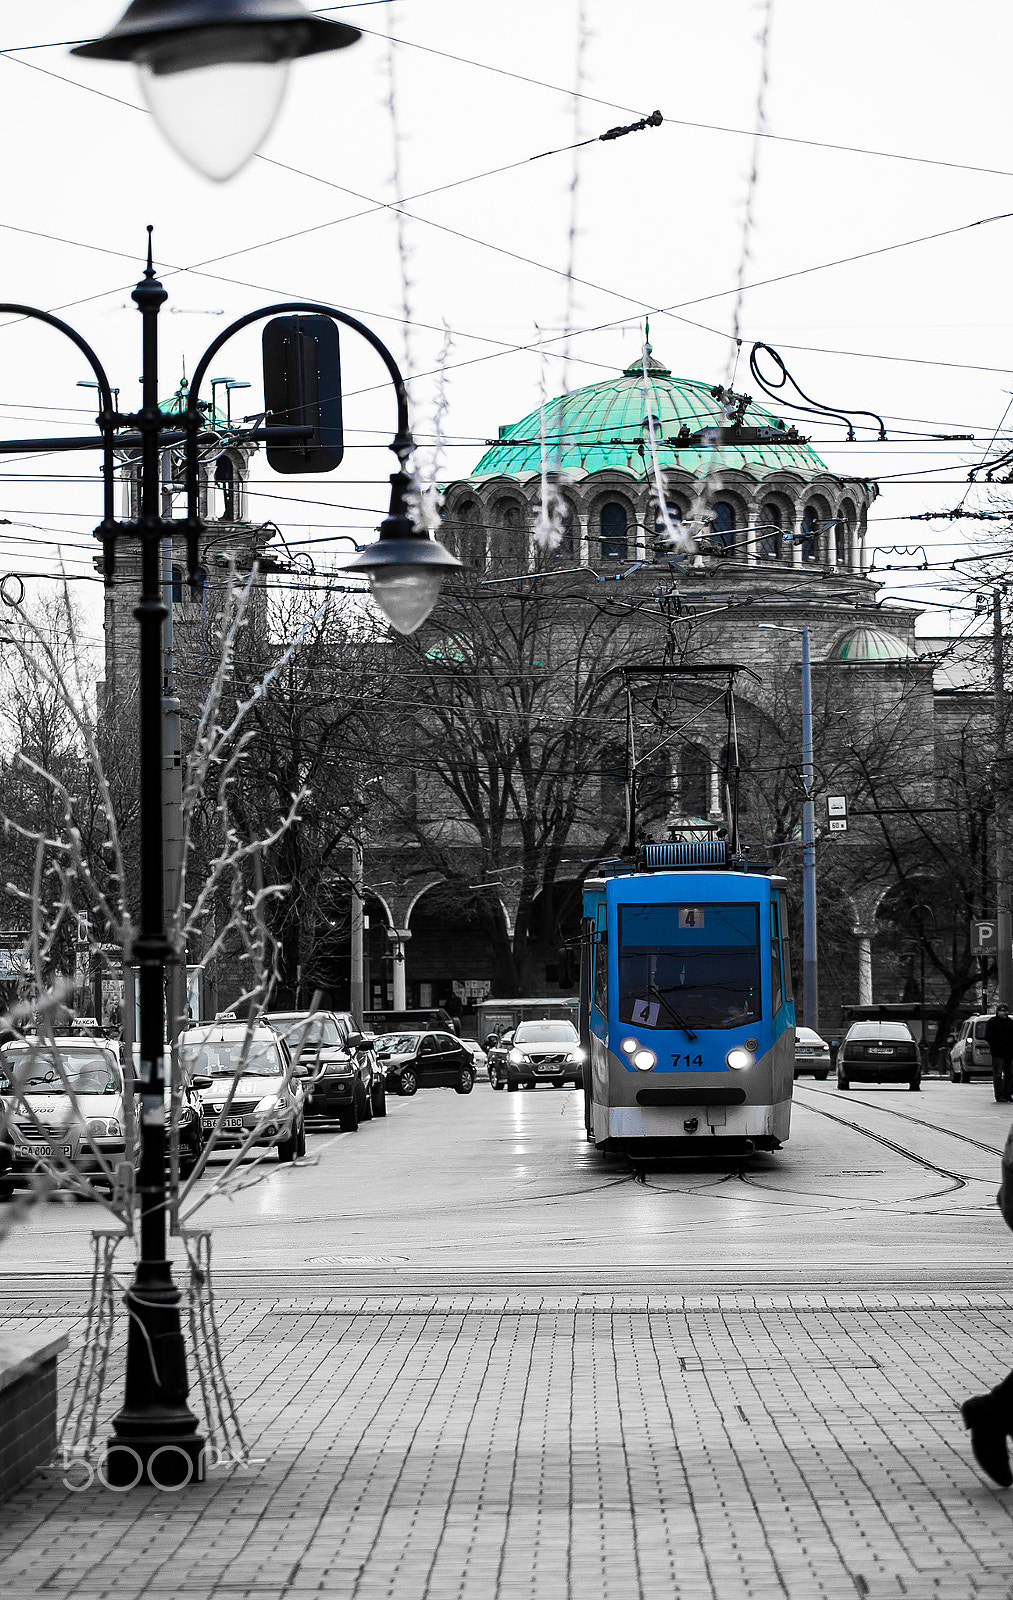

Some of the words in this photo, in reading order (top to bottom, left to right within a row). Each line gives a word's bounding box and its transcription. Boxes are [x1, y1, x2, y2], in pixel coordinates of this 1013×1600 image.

[685, 911, 695, 927] 4
[979, 926, 992, 946] P
[639, 1005, 650, 1022] 4
[670, 1054, 703, 1067] 714
